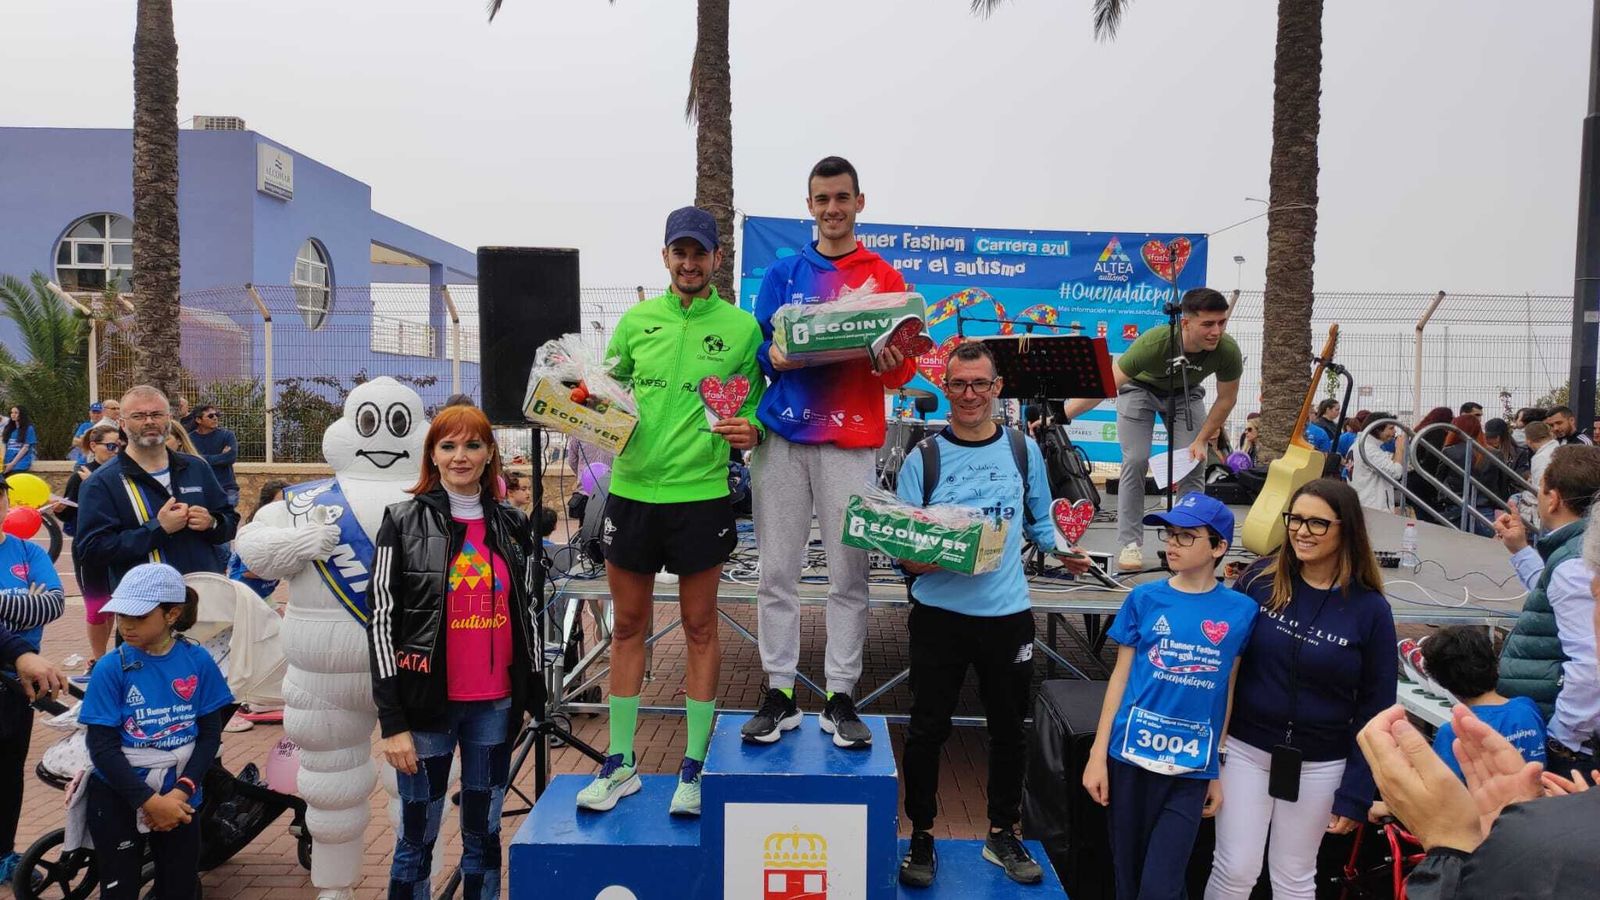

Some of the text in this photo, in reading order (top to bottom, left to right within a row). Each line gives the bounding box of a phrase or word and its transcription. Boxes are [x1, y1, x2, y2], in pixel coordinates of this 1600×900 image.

[903, 233, 965, 252] Fashion
[976, 237, 1069, 256] Carrera azul
[893, 257, 1026, 278] por el autismo
[1093, 262, 1134, 274] ALTEA
[549, 407, 620, 443] ECOINVER
[870, 523, 968, 553] ECOINVER
[1260, 606, 1299, 628] POLO
[1136, 728, 1199, 758] 3004
